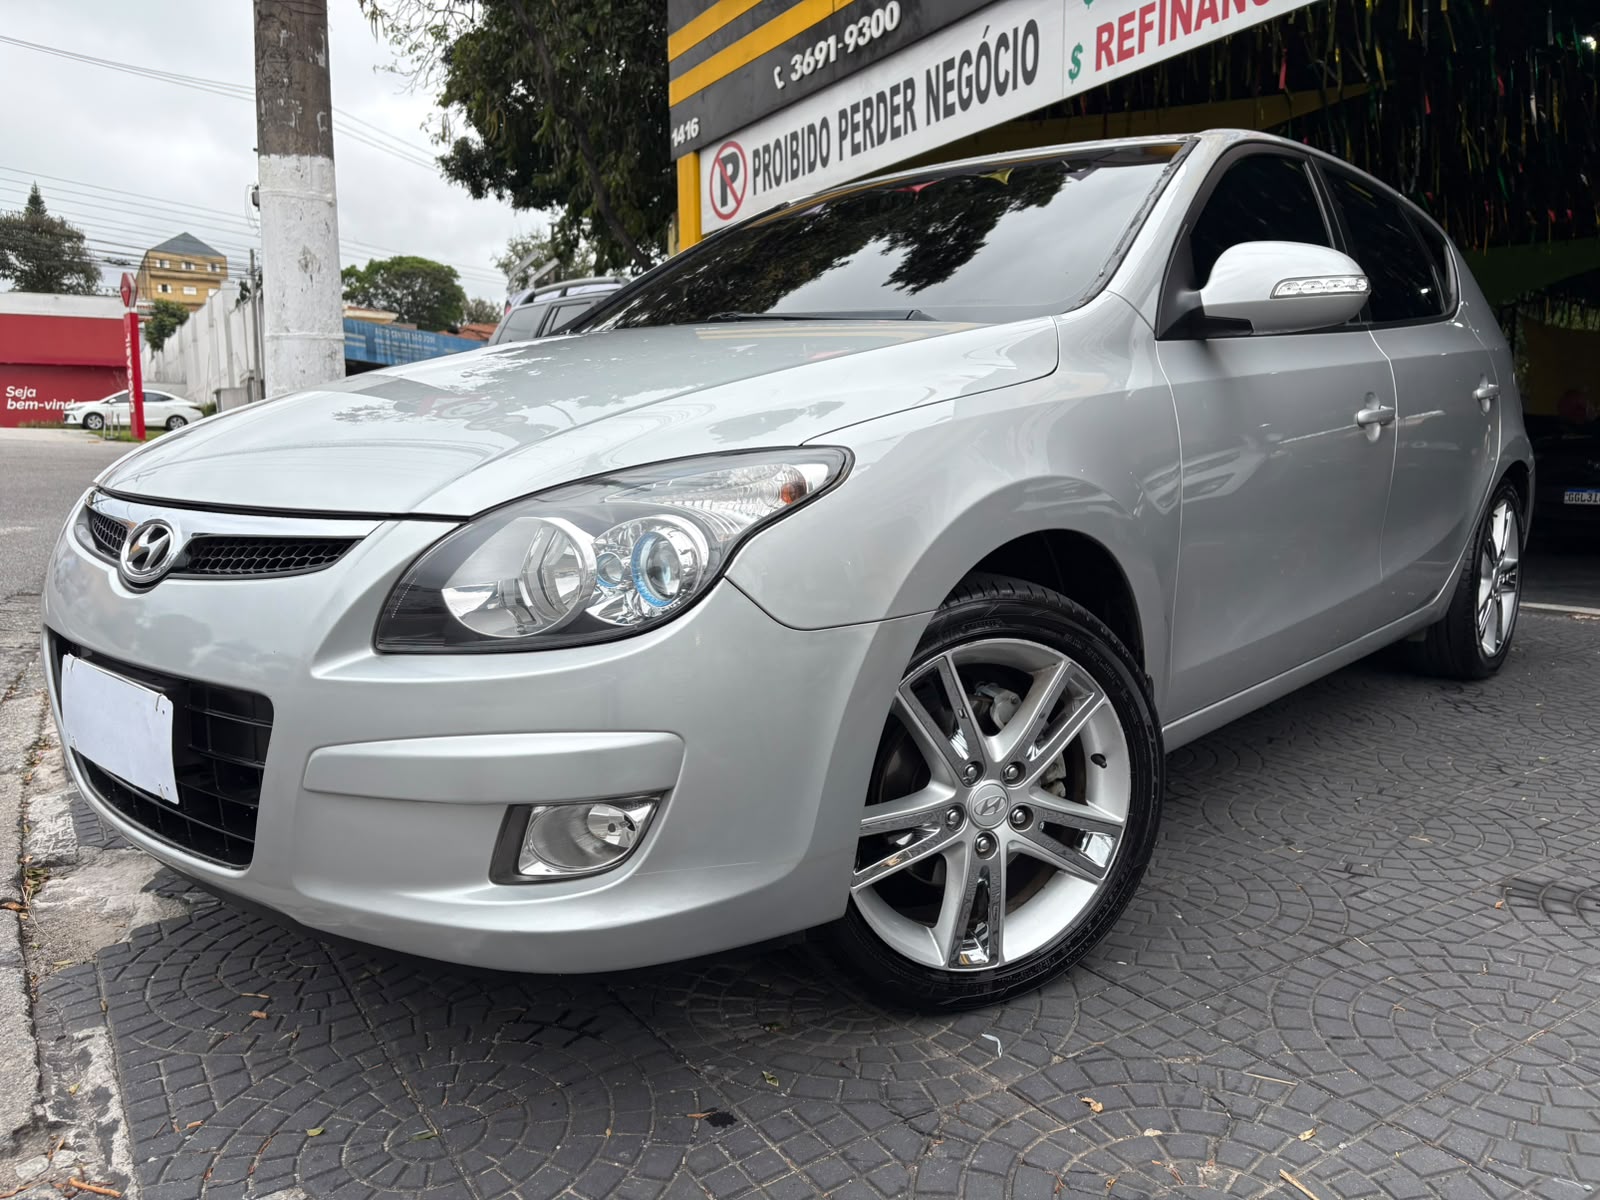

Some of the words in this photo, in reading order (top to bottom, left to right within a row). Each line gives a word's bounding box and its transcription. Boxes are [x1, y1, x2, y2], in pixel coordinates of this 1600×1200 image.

[790, 1, 900, 81] 3691-9300
[672, 118, 699, 147] 1416
[752, 116, 831, 195] PROIBIDO
[838, 77, 917, 162] PERDER
[925, 19, 1039, 127] NEGÓCIO
[5, 386, 37, 400] Seja
